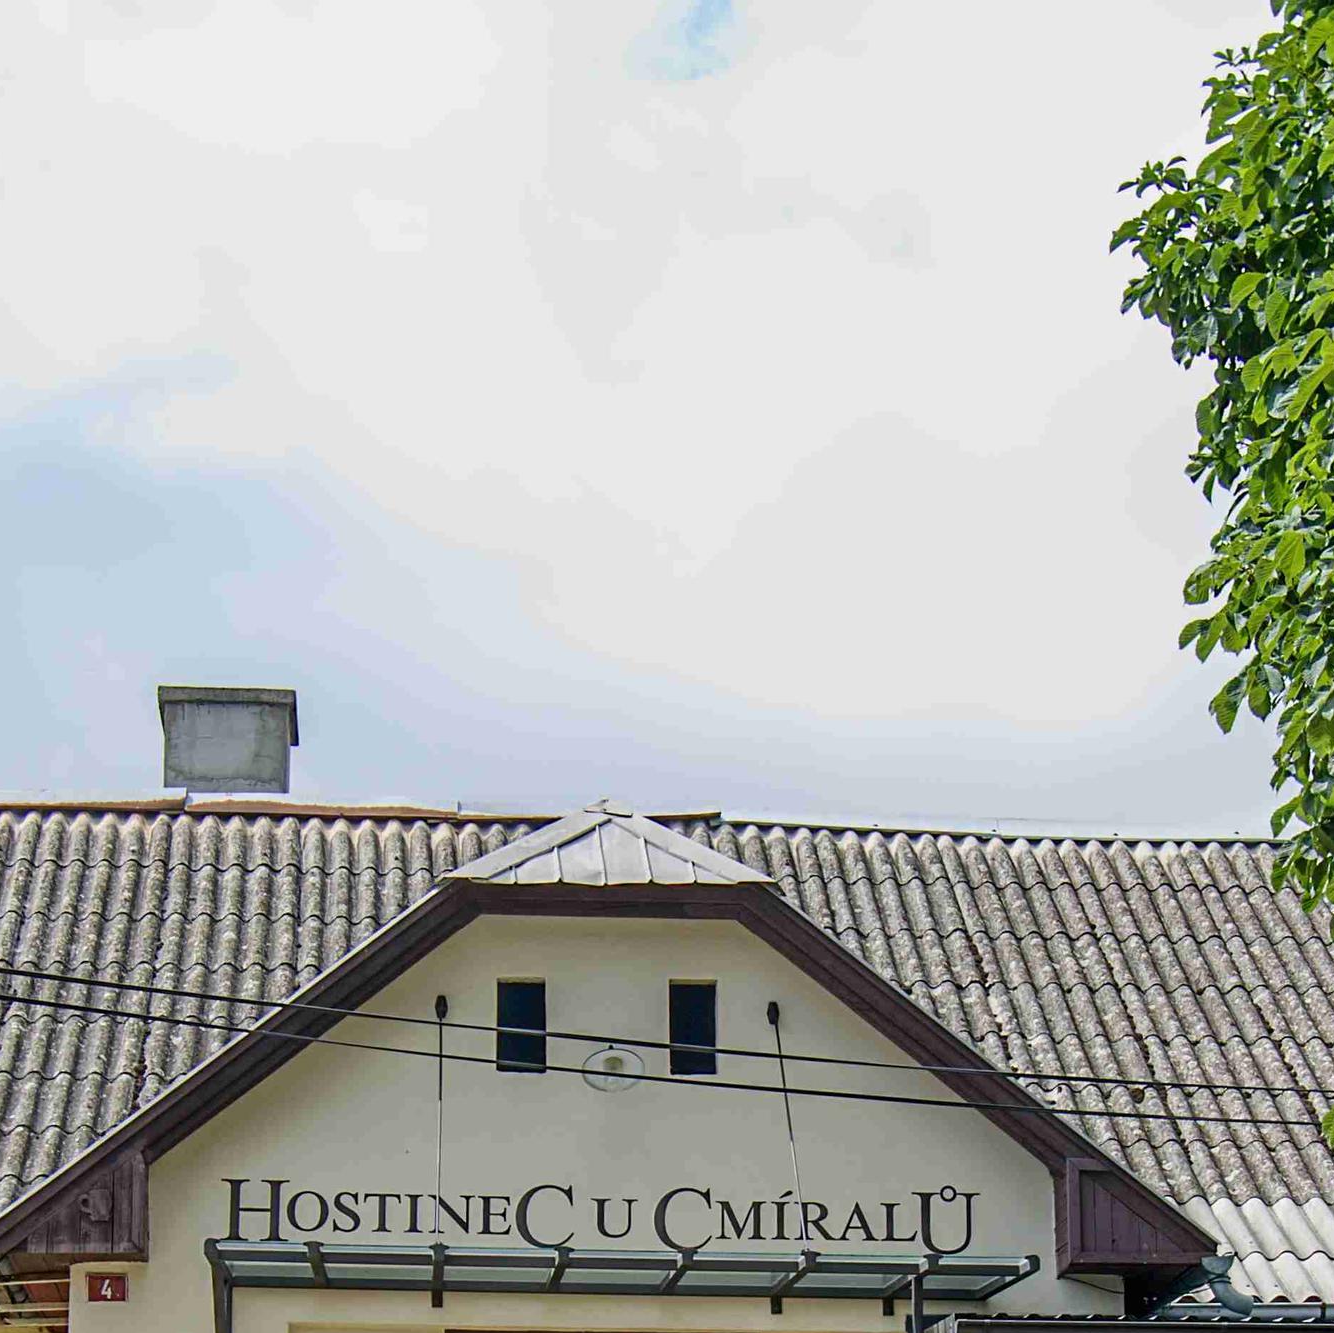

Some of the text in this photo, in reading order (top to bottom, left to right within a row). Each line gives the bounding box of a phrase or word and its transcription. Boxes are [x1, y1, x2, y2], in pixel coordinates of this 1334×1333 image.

[222, 1178, 980, 1255] HOSTINEC U CMÍRALŮ
[101, 1279, 113, 1300] 4
